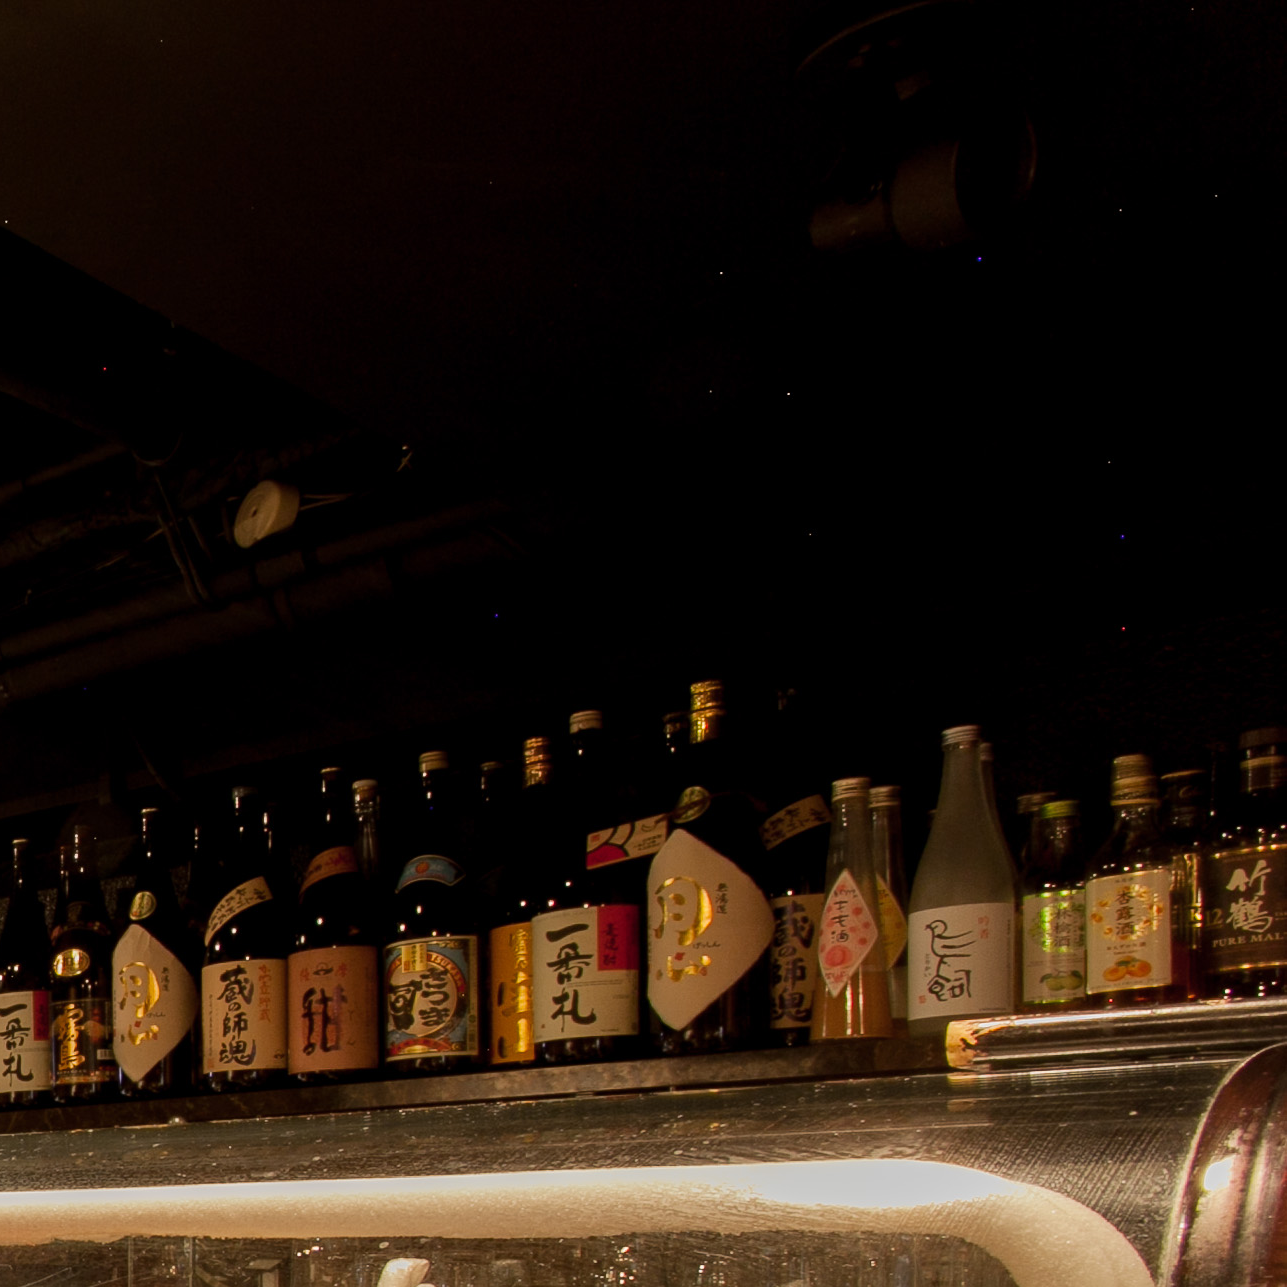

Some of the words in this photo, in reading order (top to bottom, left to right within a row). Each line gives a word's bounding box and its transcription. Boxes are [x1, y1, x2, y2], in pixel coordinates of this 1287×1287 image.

[1225, 859, 1274, 933] 竹鶴
[545, 923, 598, 1034] 一番札
[1212, 935, 1247, 948] PURE
[217, 964, 257, 1067] 蔵の師魂
